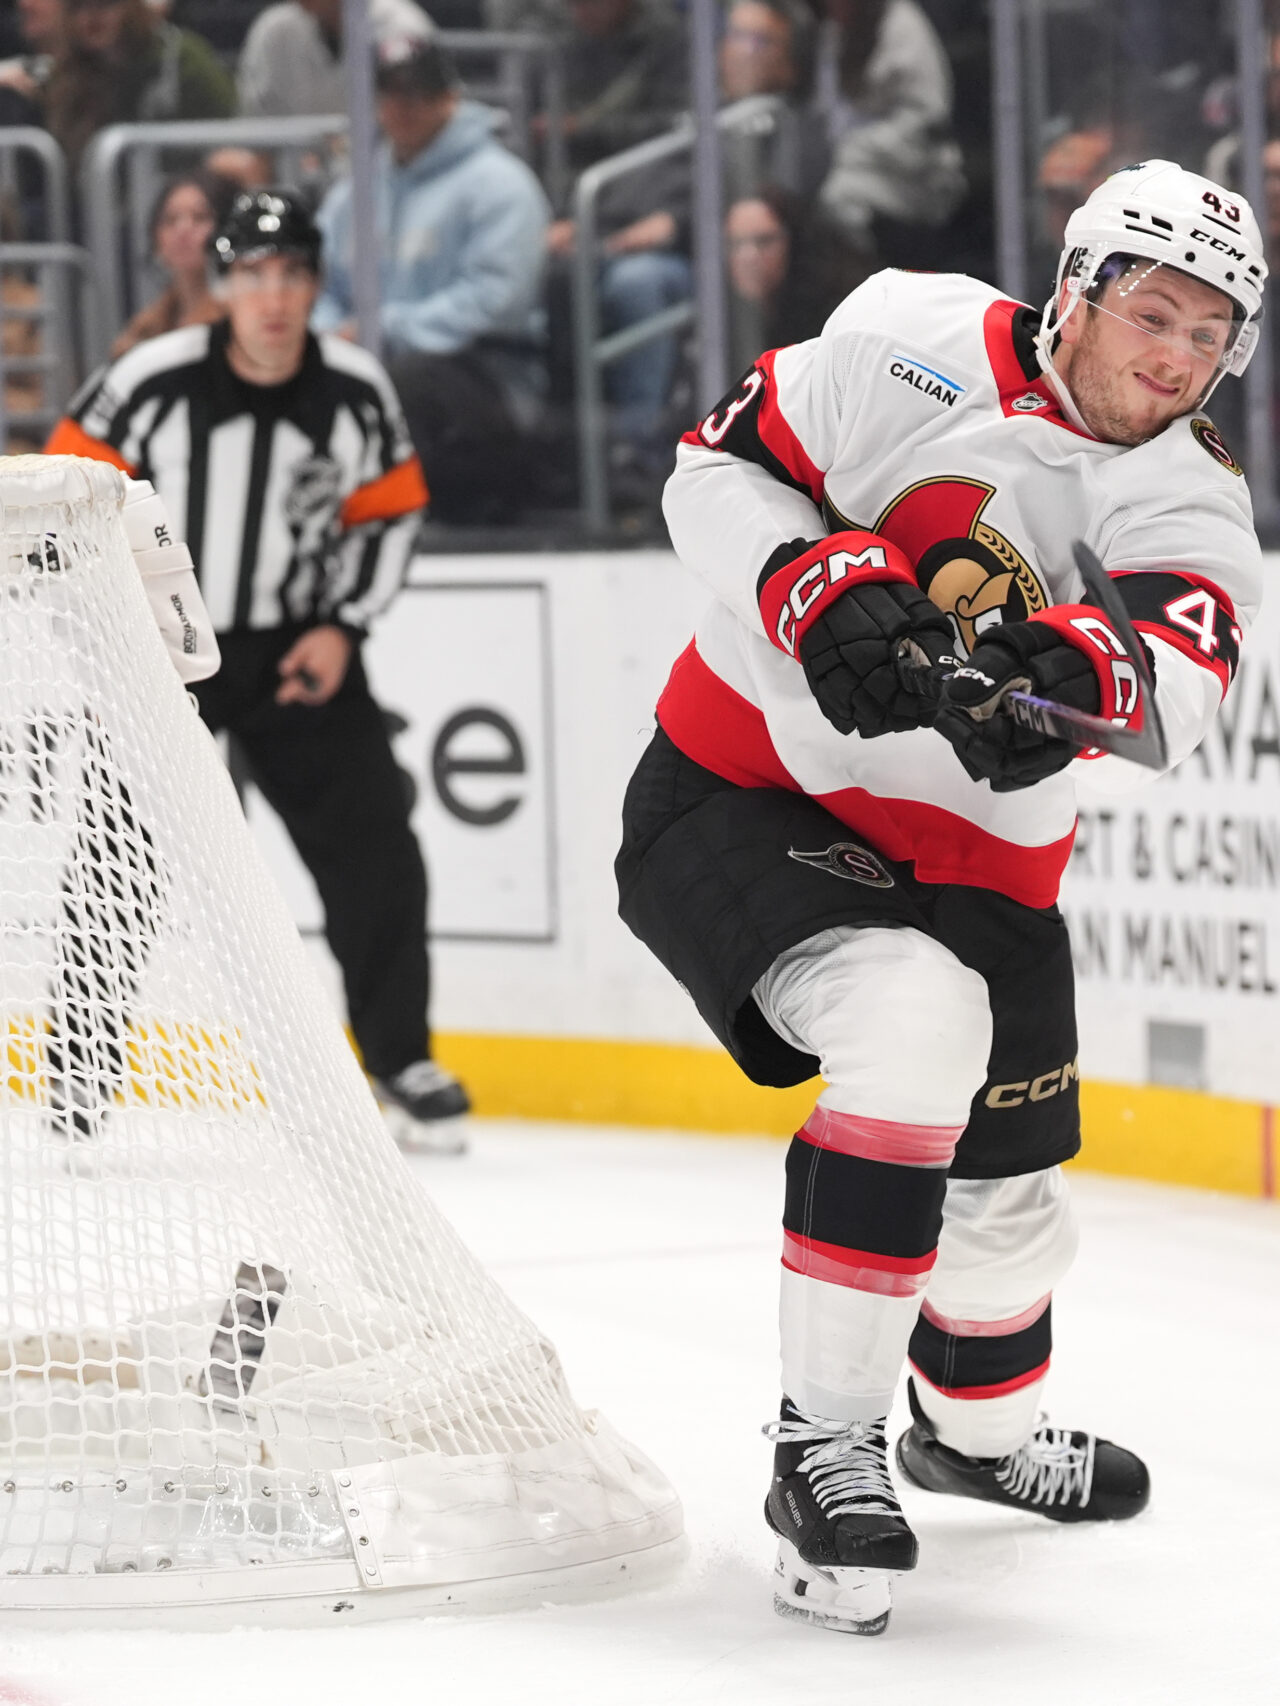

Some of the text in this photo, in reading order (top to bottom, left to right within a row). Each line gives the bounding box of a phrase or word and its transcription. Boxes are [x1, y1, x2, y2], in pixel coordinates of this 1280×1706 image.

[1202, 191, 1241, 222] 43
[1189, 228, 1247, 262] CCM
[890, 362, 958, 407] CALIAN
[170, 593, 194, 654] BODYARMOR
[777, 546, 888, 657] CCM
[1163, 588, 1243, 672] 4
[1133, 812, 1153, 881] &
[1122, 912, 1278, 993] MANUEL
[985, 1056, 1080, 1109] CCM
[785, 1490, 803, 1529] BAUER
